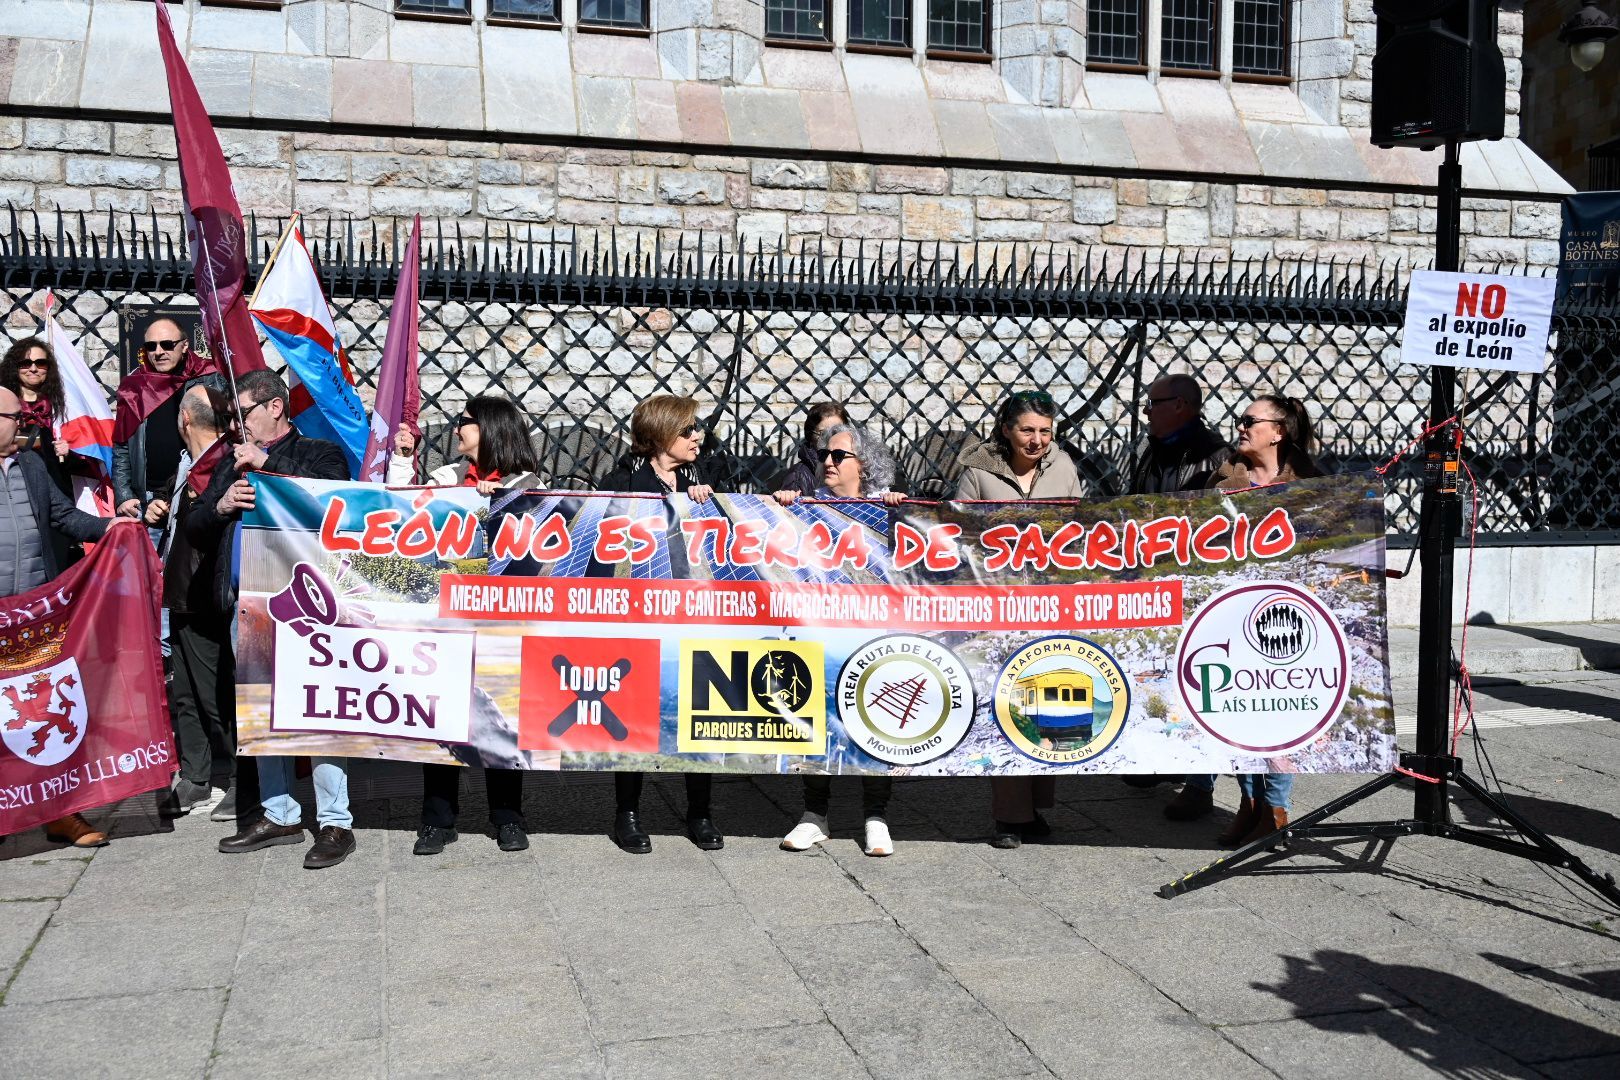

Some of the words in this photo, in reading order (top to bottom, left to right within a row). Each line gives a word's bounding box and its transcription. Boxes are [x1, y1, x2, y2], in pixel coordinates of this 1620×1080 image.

[1565, 250, 1619, 260] BOTINES
[1566, 241, 1597, 251] CASA
[1455, 282, 1507, 319] NO
[1429, 314, 1447, 332] al
[1453, 318, 1526, 338] expolio
[1435, 337, 1458, 356] de
[1465, 339, 1513, 360] León
[318, 493, 477, 560] LEÓN
[492, 512, 571, 562] NO
[593, 514, 668, 565] ES
[682, 516, 871, 570] TIERRA
[892, 520, 962, 571] DE
[981, 507, 1297, 573] SACRIFICIO
[450, 584, 555, 613] MEGAPLANTAS
[567, 588, 630, 615] SOLARES
[643, 590, 681, 616] STOP
[685, 591, 757, 617] CANTERAS
[769, 592, 888, 619] MACROGRANJAS
[903, 595, 992, 622] VERTEDEROS
[997, 592, 1060, 622] TÓXICOS
[1074, 596, 1114, 619] STOP
[1118, 586, 1172, 618] BIOGÁS
[308, 632, 438, 676] S.O.S
[559, 665, 621, 692] LODOS
[691, 649, 813, 715] NO
[844, 671, 860, 710] TREN
[856, 644, 895, 669] RUTA
[900, 643, 921, 655] DE
[925, 650, 942, 667] LA
[943, 666, 962, 710] PLATA
[1000, 643, 1071, 695] PLATAFORMA
[1077, 646, 1121, 694] DEFENSA
[302, 682, 440, 729] LEÓN
[576, 700, 602, 726] NO
[1251, 695, 1319, 713] LLIONÉS
[694, 720, 753, 739] PARQUES
[756, 718, 810, 740] EÓLICOS
[866, 735, 942, 756] Movimiento
[1031, 747, 1059, 761] FEVE
[1064, 746, 1093, 761] LEÓN
[38, 766, 81, 802] PAÍS
[84, 741, 169, 784] LLINÉS
